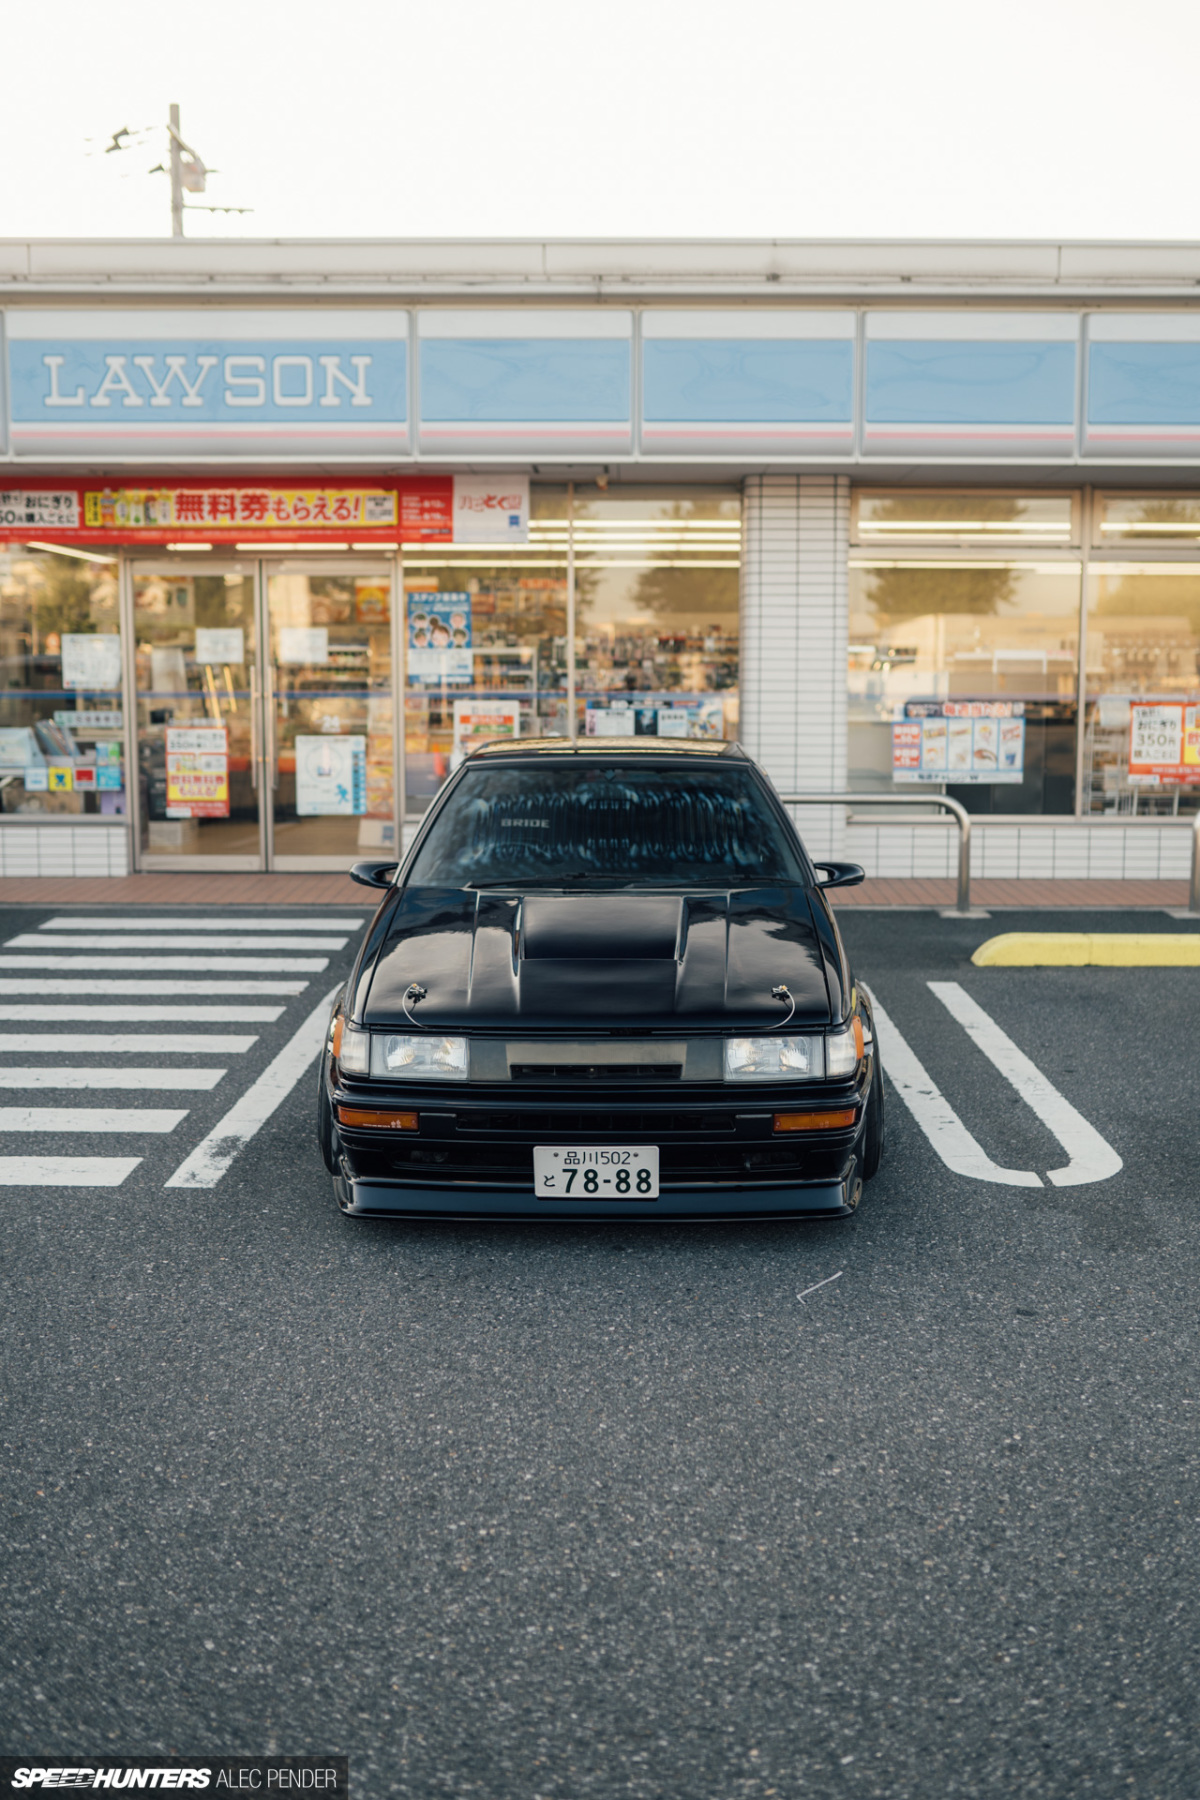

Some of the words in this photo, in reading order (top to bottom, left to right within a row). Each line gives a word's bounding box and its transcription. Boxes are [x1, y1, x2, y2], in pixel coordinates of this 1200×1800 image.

[42, 354, 374, 407] LAWSON
[25, 494, 73, 510] おにぎり
[174, 491, 360, 522] 無料券もらえる!
[1137, 719, 1177, 732] おにぎり
[1137, 732, 1176, 747] 350円
[501, 818, 550, 829] BRIDE
[564, 1151, 631, 1165] 品川502
[543, 1174, 556, 1187] と
[562, 1168, 652, 1194] 78-88
